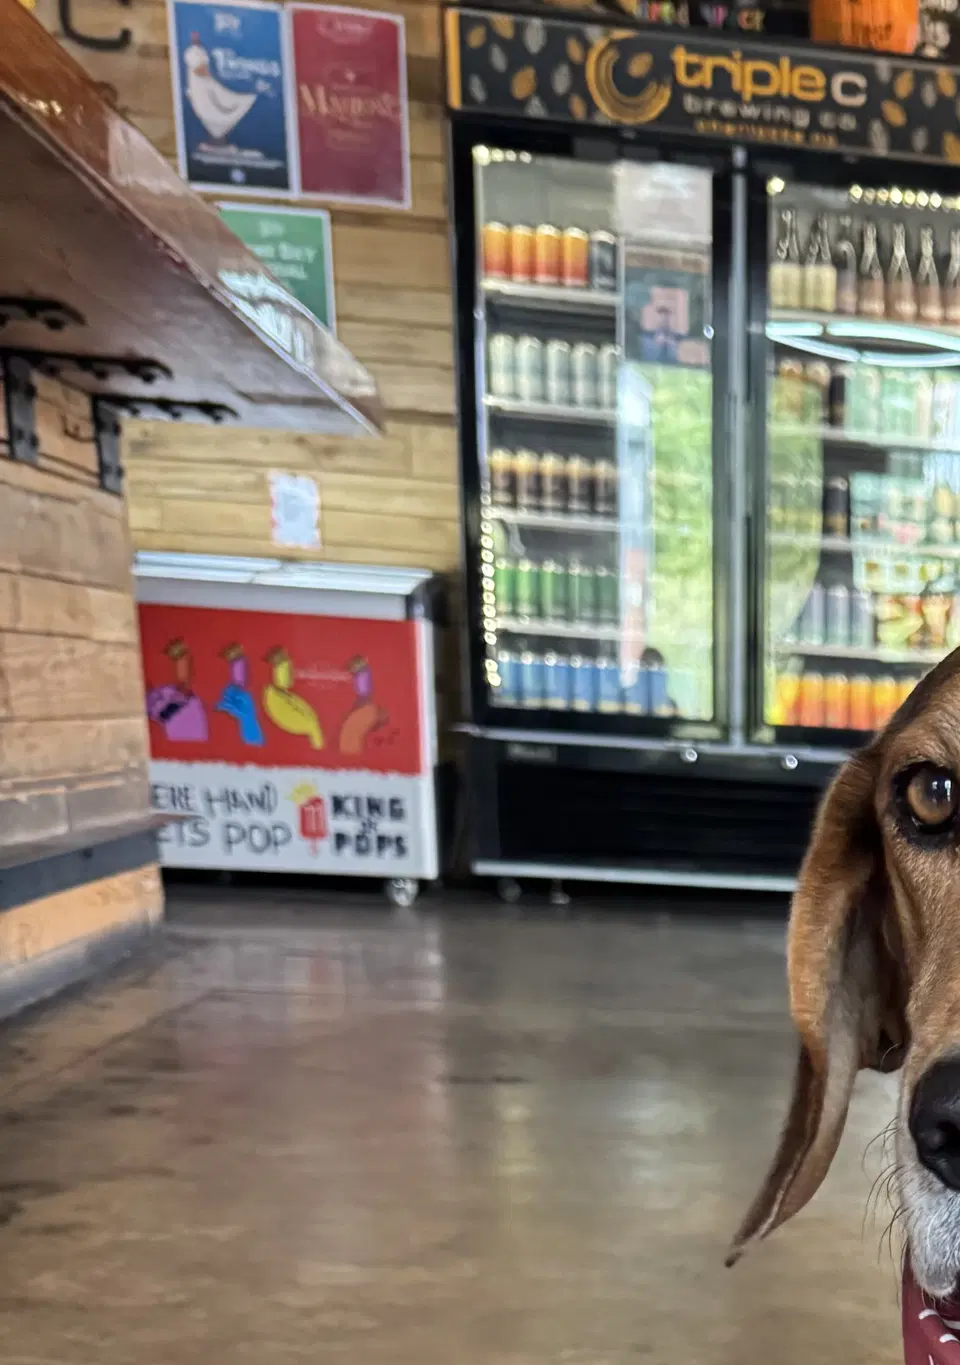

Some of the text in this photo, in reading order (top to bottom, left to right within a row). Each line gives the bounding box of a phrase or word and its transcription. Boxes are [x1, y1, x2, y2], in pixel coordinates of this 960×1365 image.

[671, 44, 827, 101] triple
[682, 93, 811, 128] brewing
[203, 784, 277, 816] HAND
[331, 794, 406, 820] KING
[223, 823, 292, 855] POP
[333, 832, 408, 857] POPS
